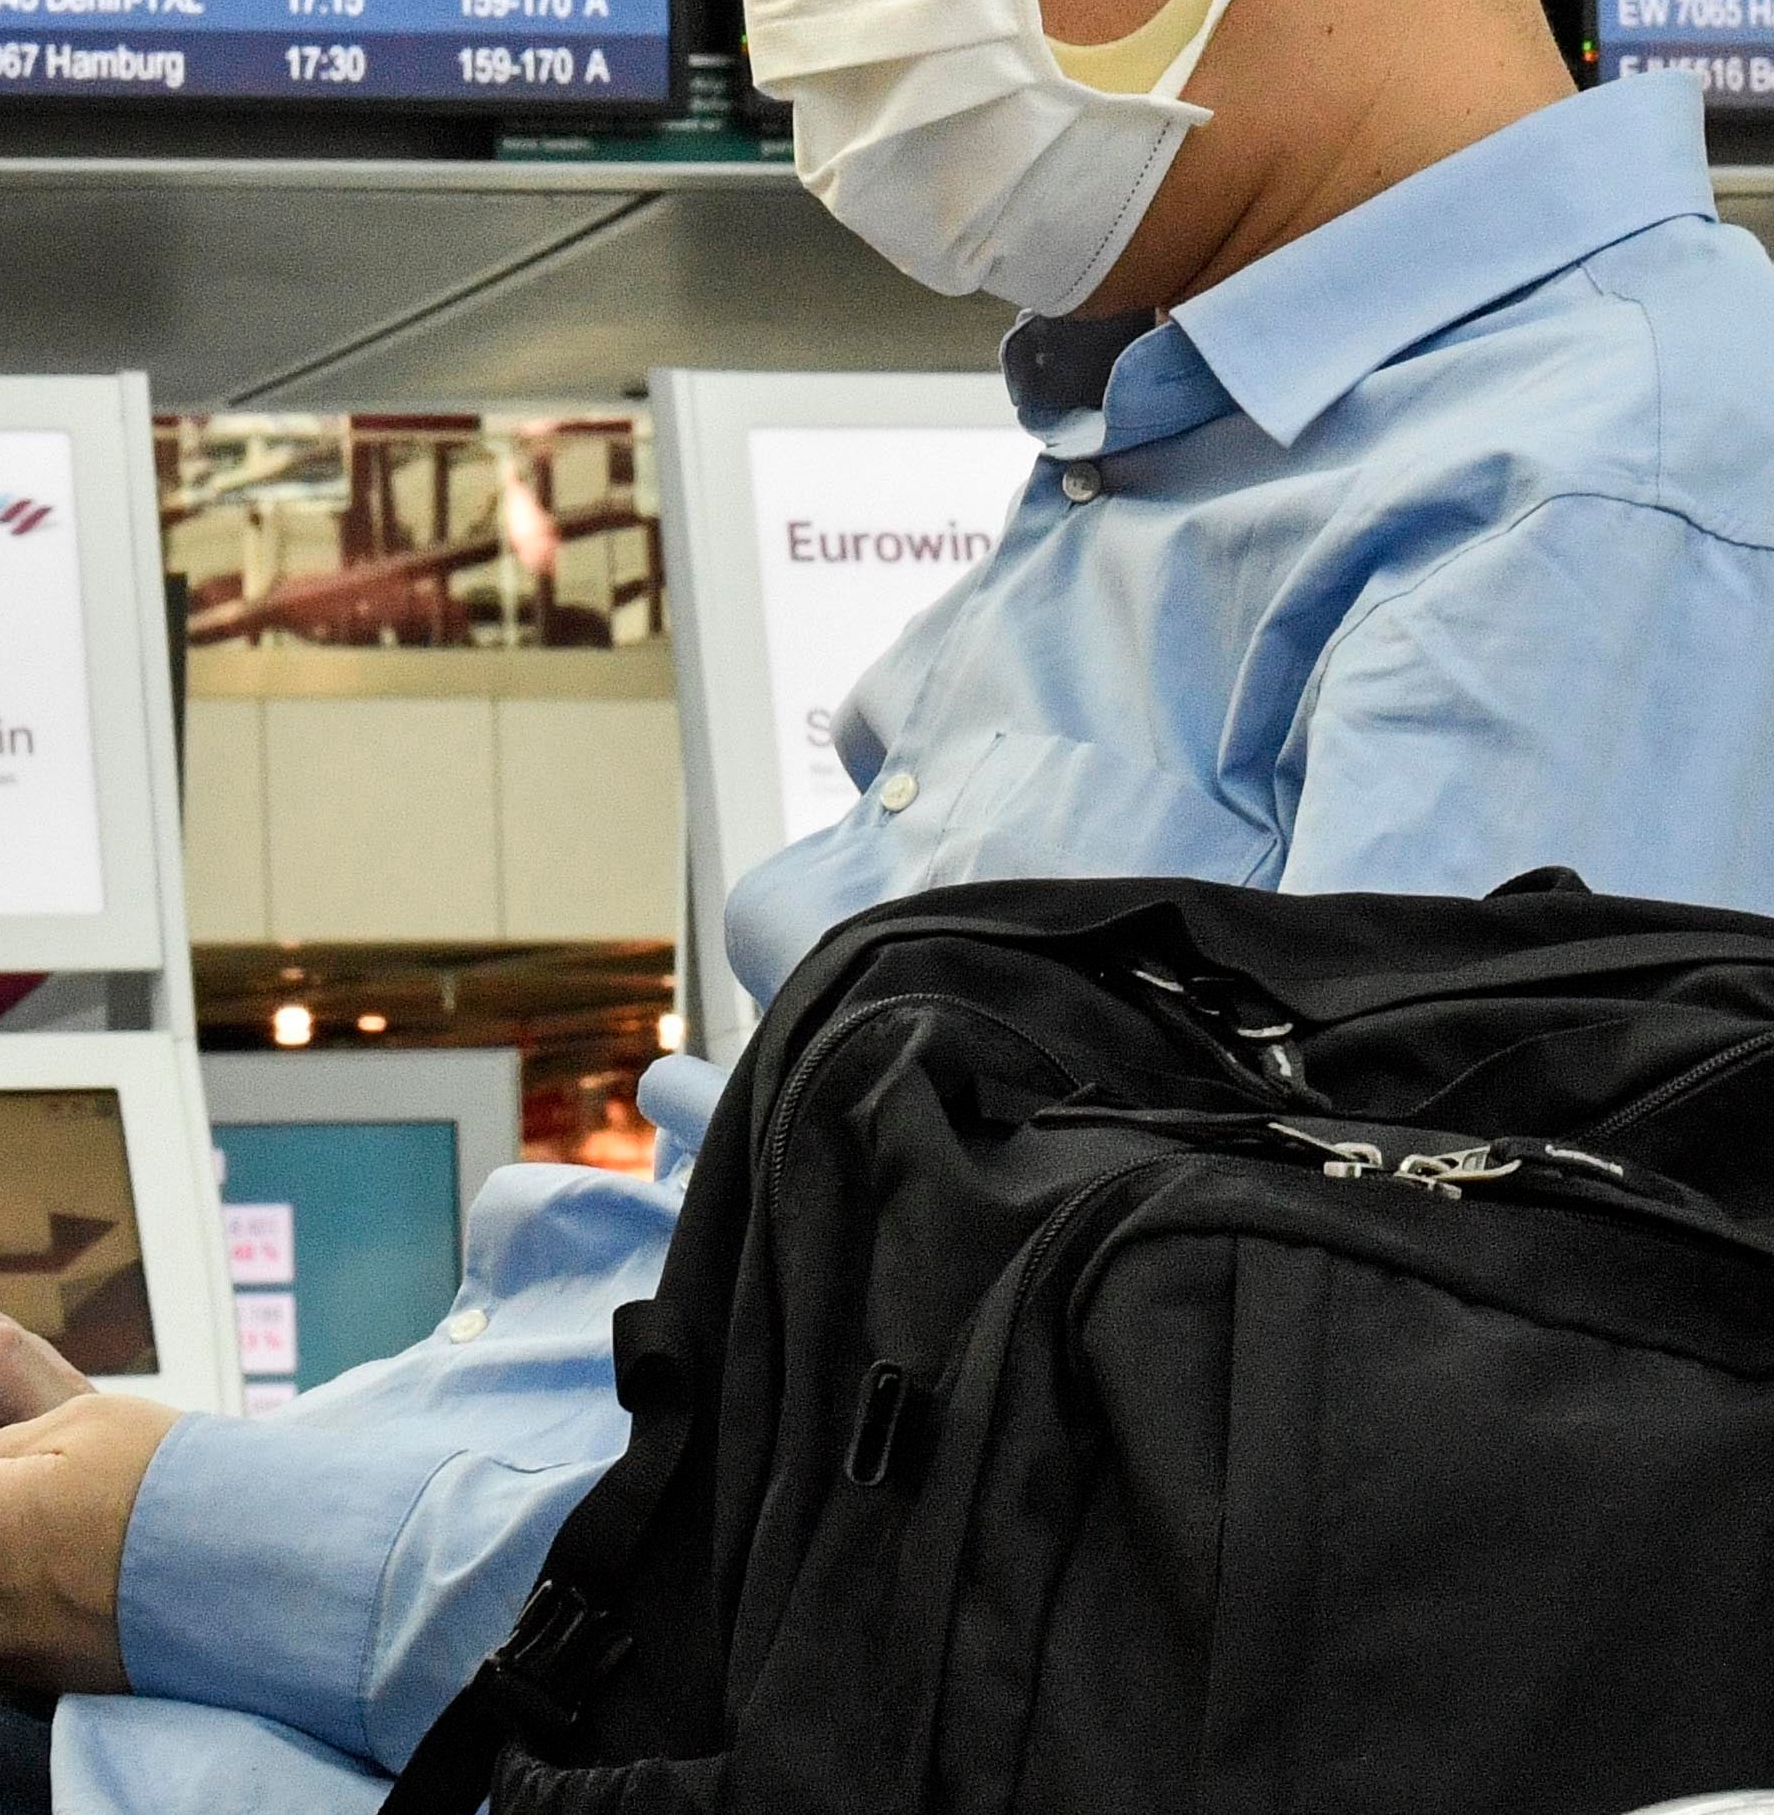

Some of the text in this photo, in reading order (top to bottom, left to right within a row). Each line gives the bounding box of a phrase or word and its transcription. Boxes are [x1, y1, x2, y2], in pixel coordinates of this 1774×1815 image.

[45, 43, 185, 89] Hamburg
[285, 44, 367, 82] 17:30
[458, 46, 574, 84] 159-170
[584, 49, 611, 83] A
[787, 520, 990, 562] Eurowin
